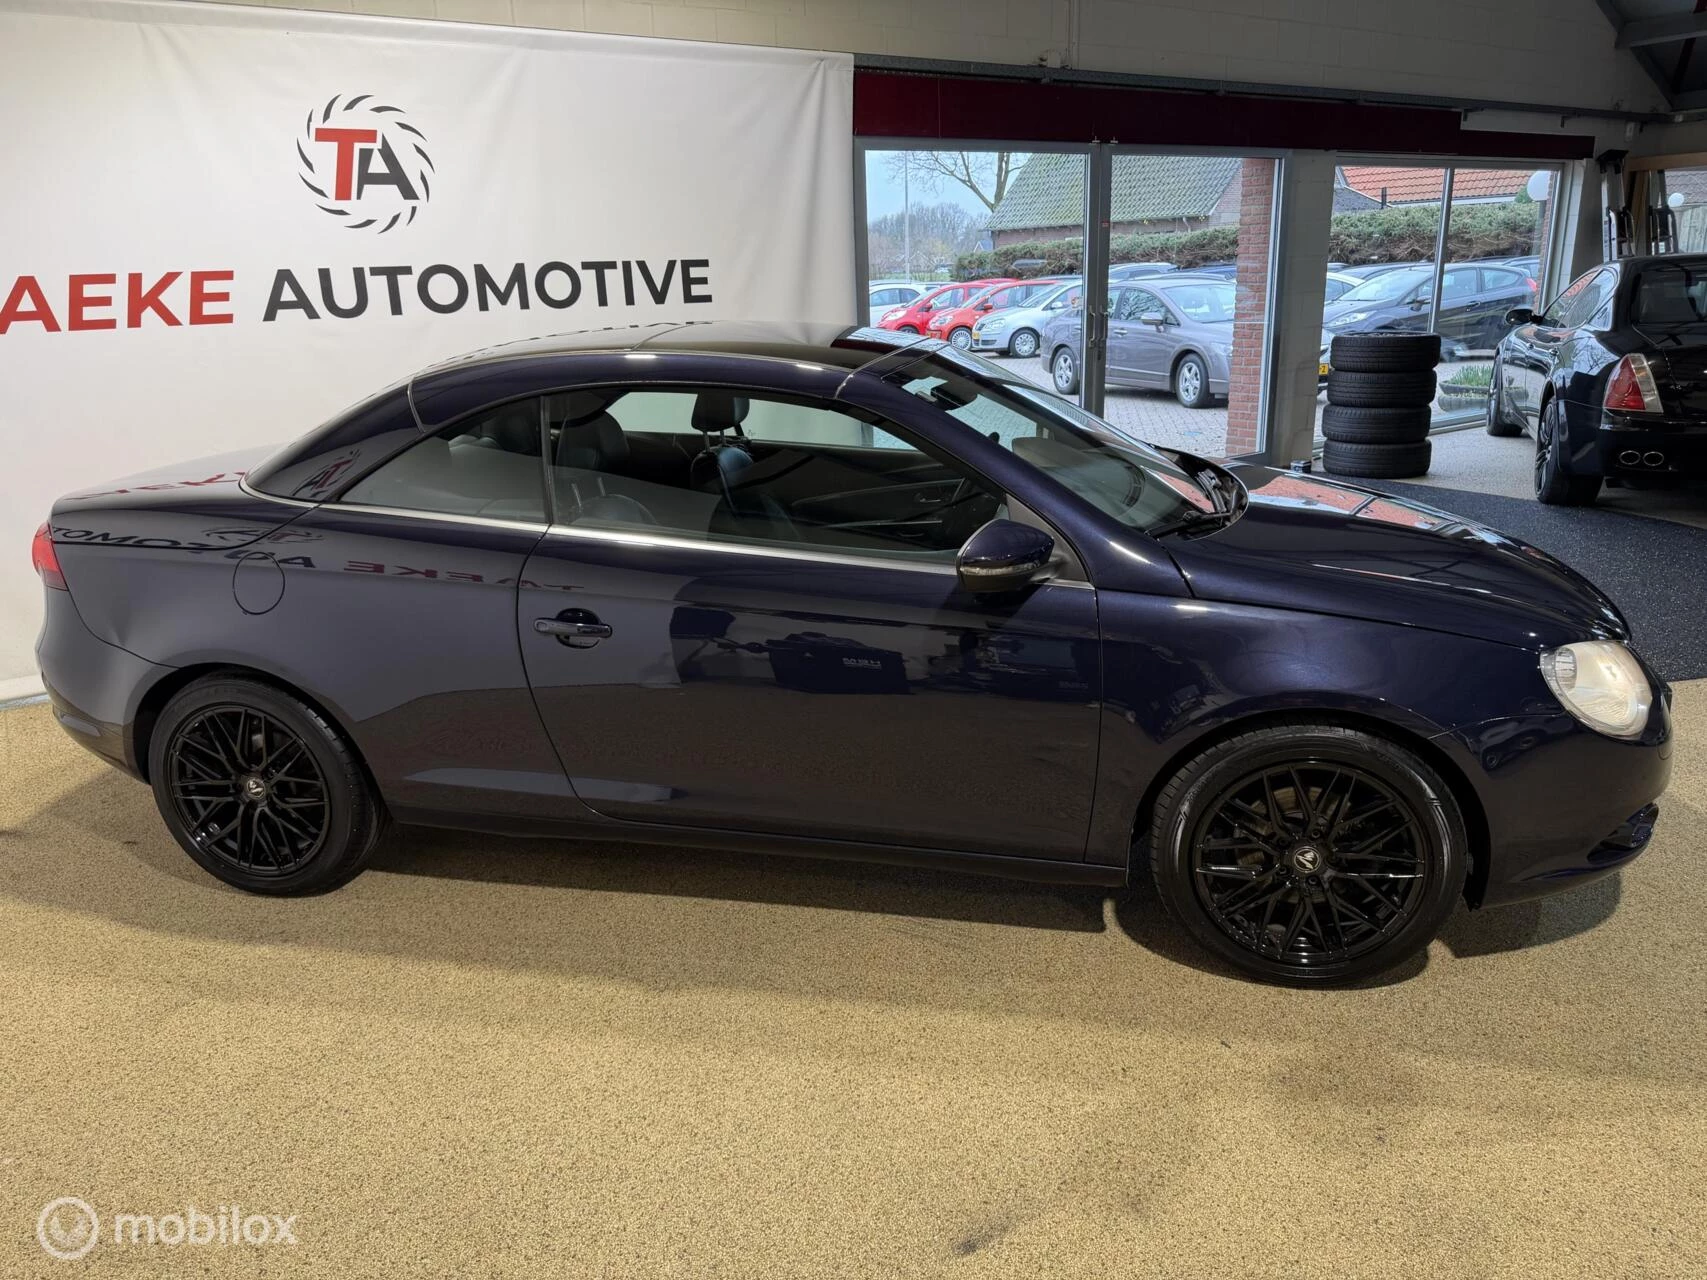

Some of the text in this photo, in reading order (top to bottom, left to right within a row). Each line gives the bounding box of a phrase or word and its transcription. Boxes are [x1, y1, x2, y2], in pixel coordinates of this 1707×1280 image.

[315, 127, 419, 201] TA
[0, 258, 713, 334] AEKE AUTOMOTIVE
